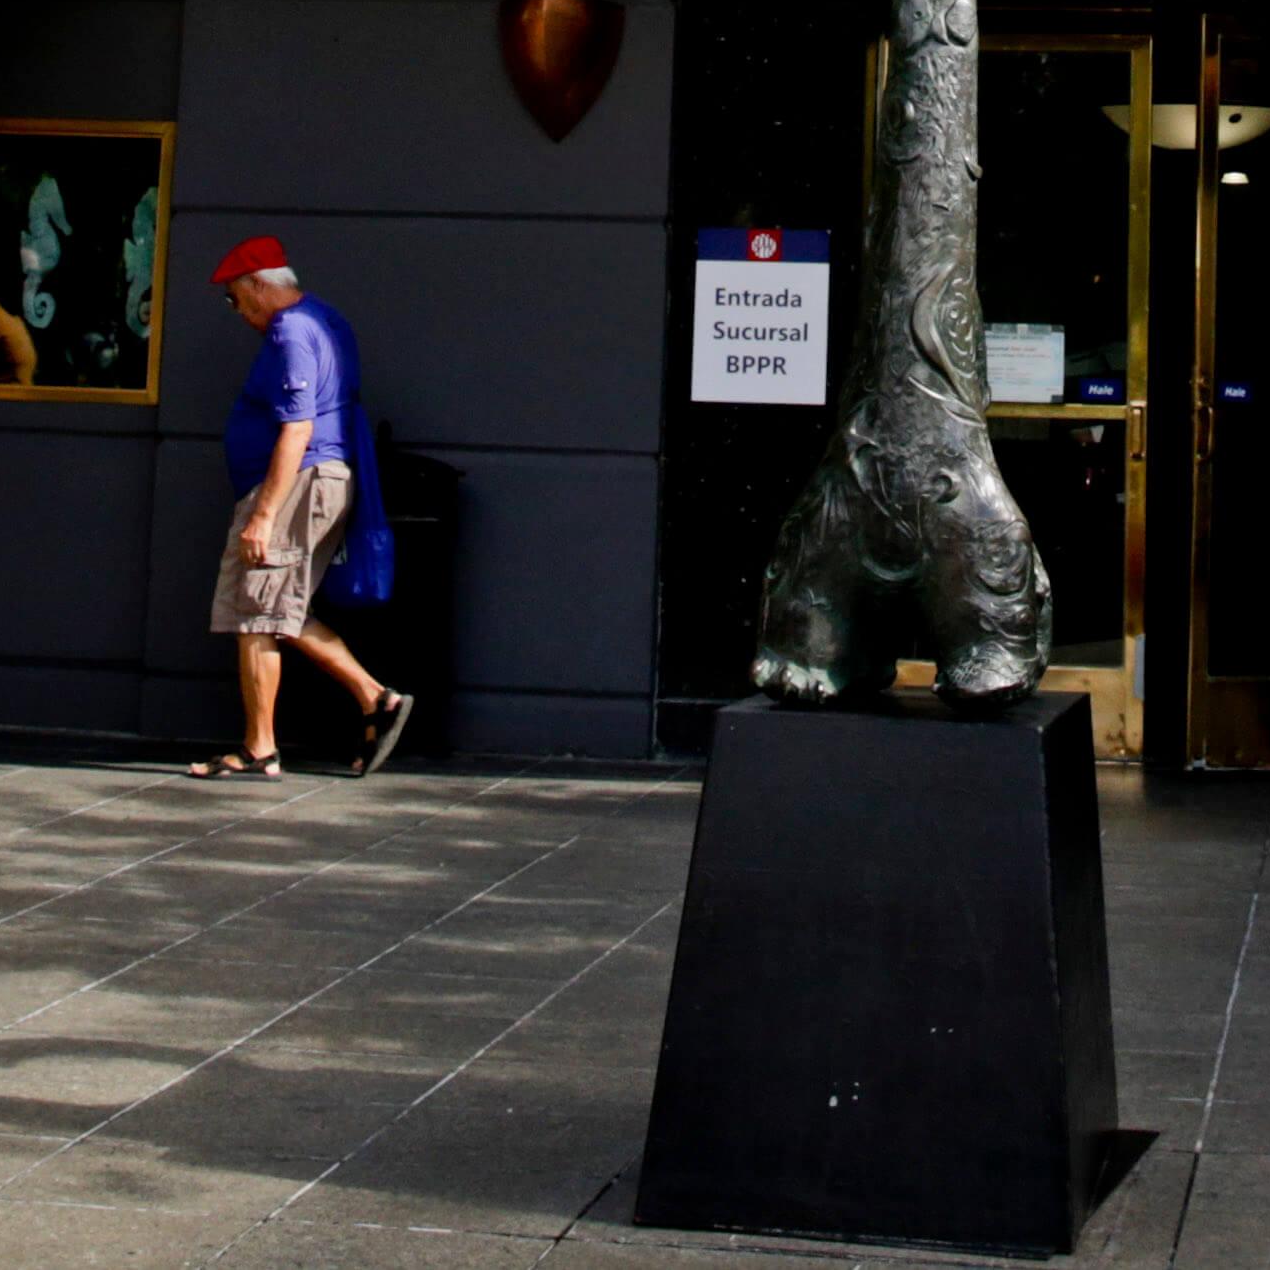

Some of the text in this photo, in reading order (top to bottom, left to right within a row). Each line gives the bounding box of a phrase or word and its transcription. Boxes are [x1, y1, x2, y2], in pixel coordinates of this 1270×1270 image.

[714, 287, 802, 308] Entrada
[713, 321, 809, 342] Sucursal
[726, 355, 787, 375] BPPR
[1087, 384, 1115, 396] Hale
[1224, 386, 1247, 398] Hale
